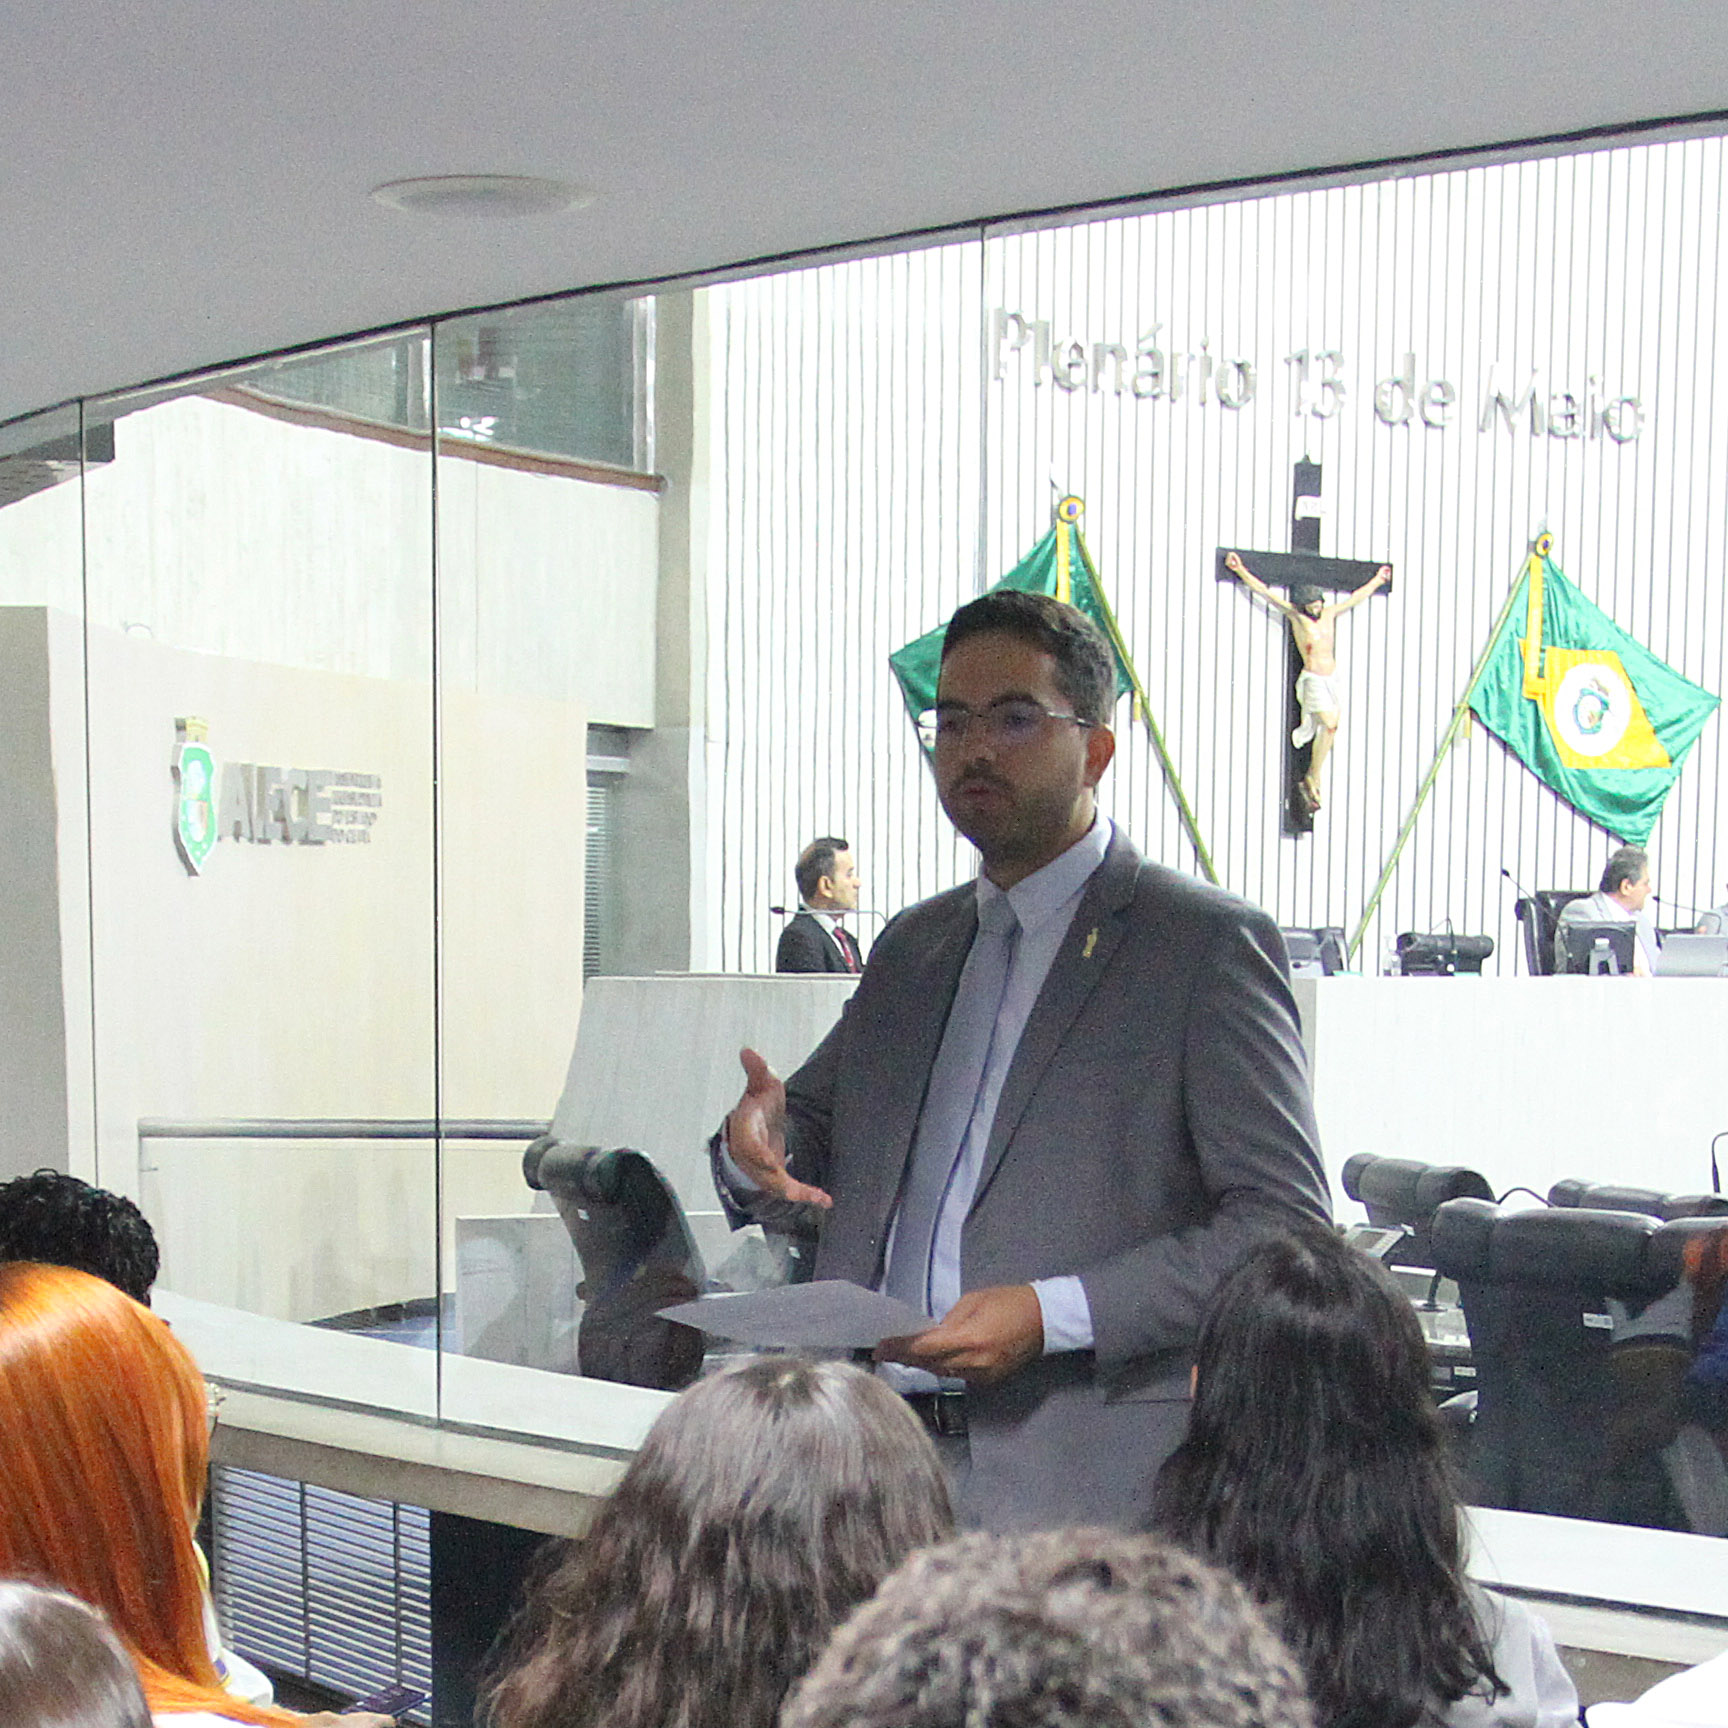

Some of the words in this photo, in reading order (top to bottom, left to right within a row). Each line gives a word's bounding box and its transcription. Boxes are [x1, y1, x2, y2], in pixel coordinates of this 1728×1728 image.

[994, 306, 1257, 410] Plenário
[1284, 348, 1346, 418] 13
[1374, 352, 1456, 428] de
[1478, 362, 1646, 444] Maio
